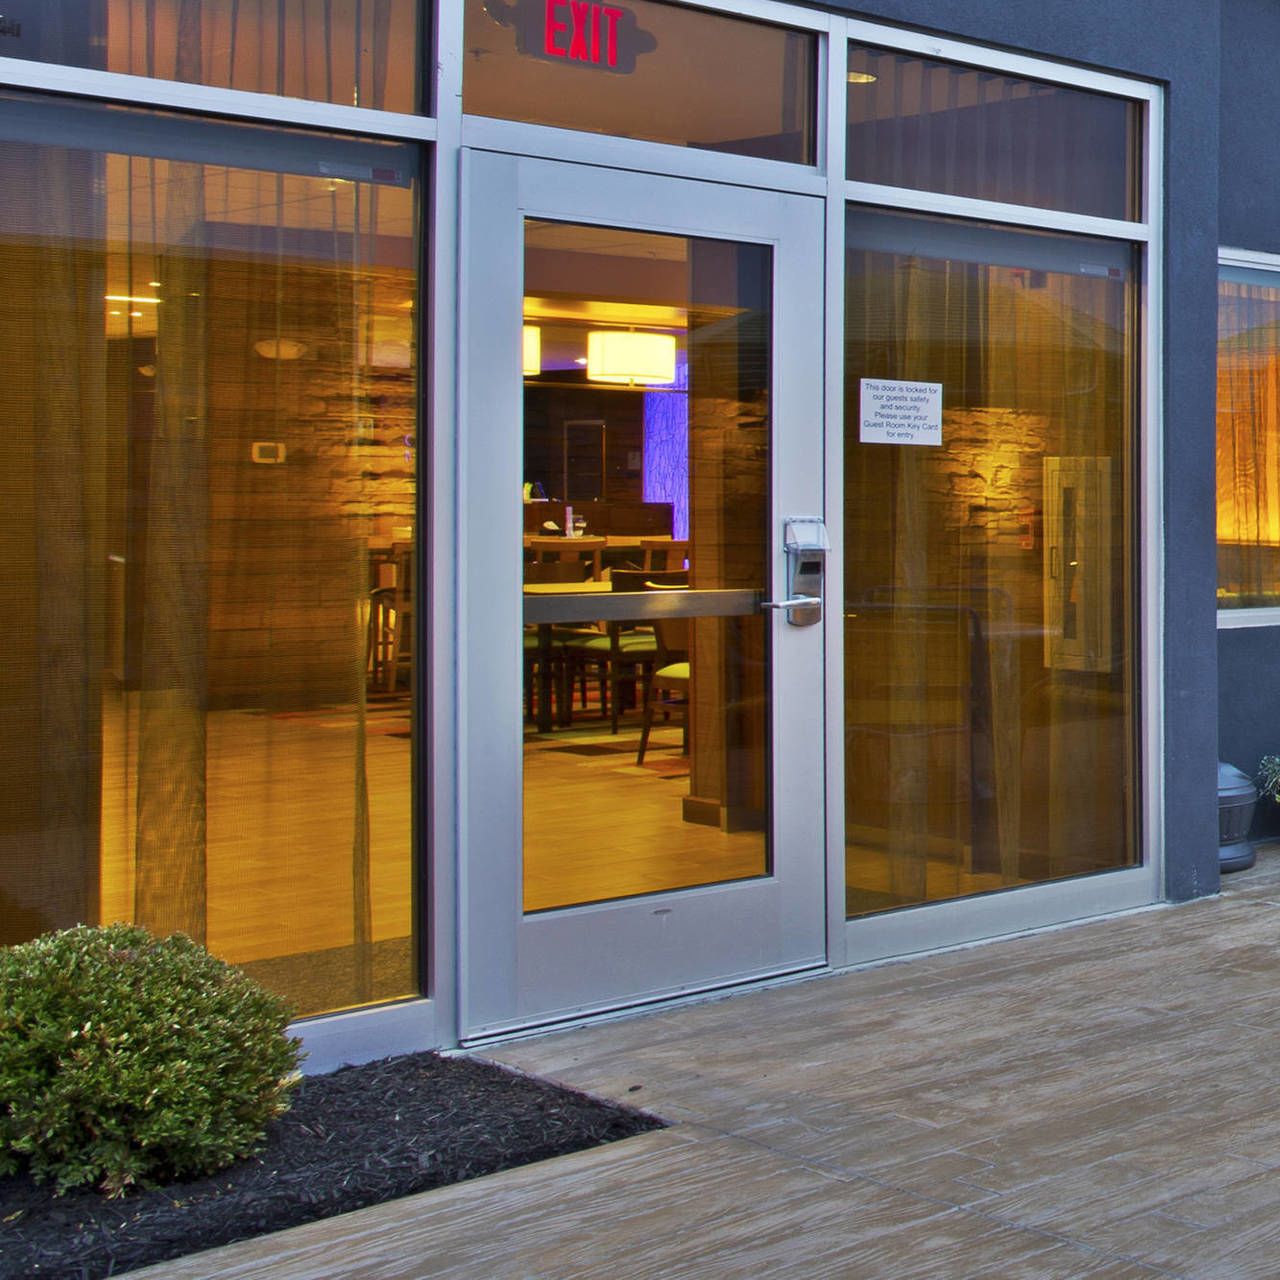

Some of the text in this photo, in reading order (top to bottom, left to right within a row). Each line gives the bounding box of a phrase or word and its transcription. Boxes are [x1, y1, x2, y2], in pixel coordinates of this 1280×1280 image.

[865, 383, 938, 394] This door is locked for
[874, 411, 897, 420] Please
[863, 420, 938, 431] Guest Room Key Card
[886, 430, 896, 438] for
